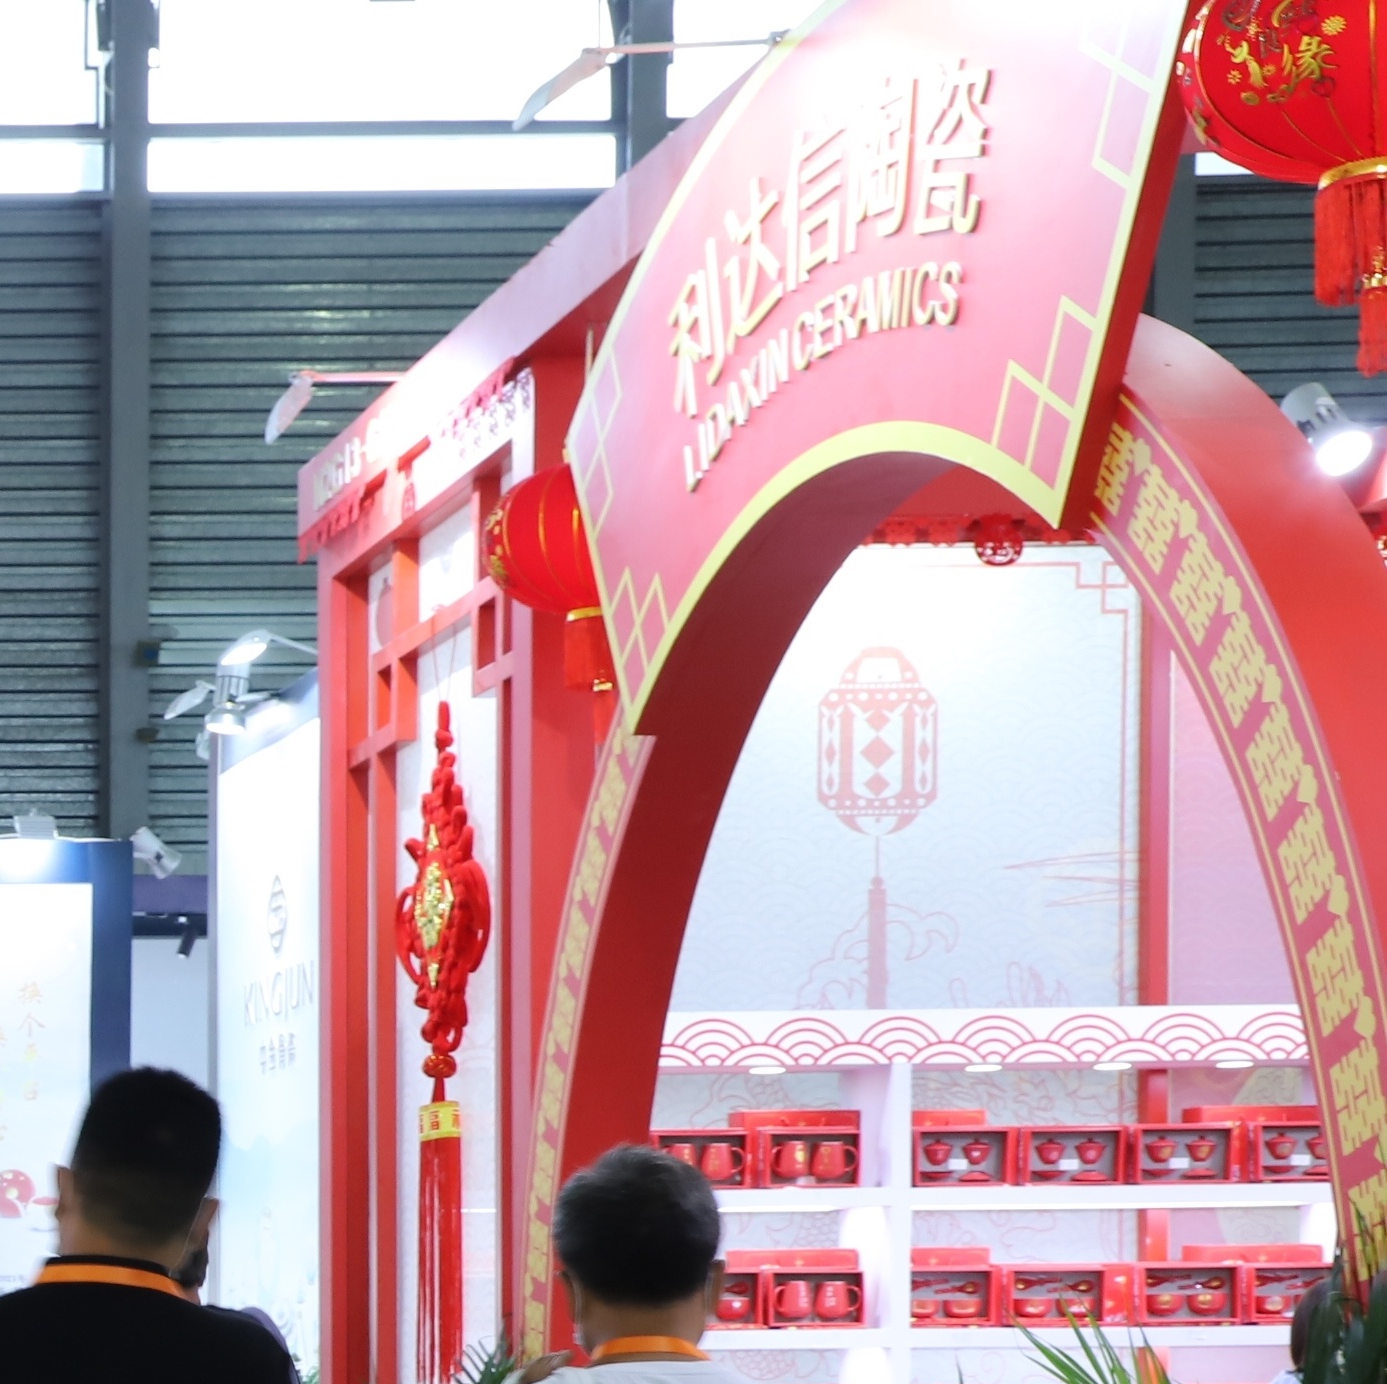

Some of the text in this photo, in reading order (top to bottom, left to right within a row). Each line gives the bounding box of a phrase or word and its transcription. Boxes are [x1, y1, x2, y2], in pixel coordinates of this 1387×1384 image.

[668, 57, 993, 420] 利达信陶瓷
[683, 260, 965, 494] LIDAXIN CERAMICS
